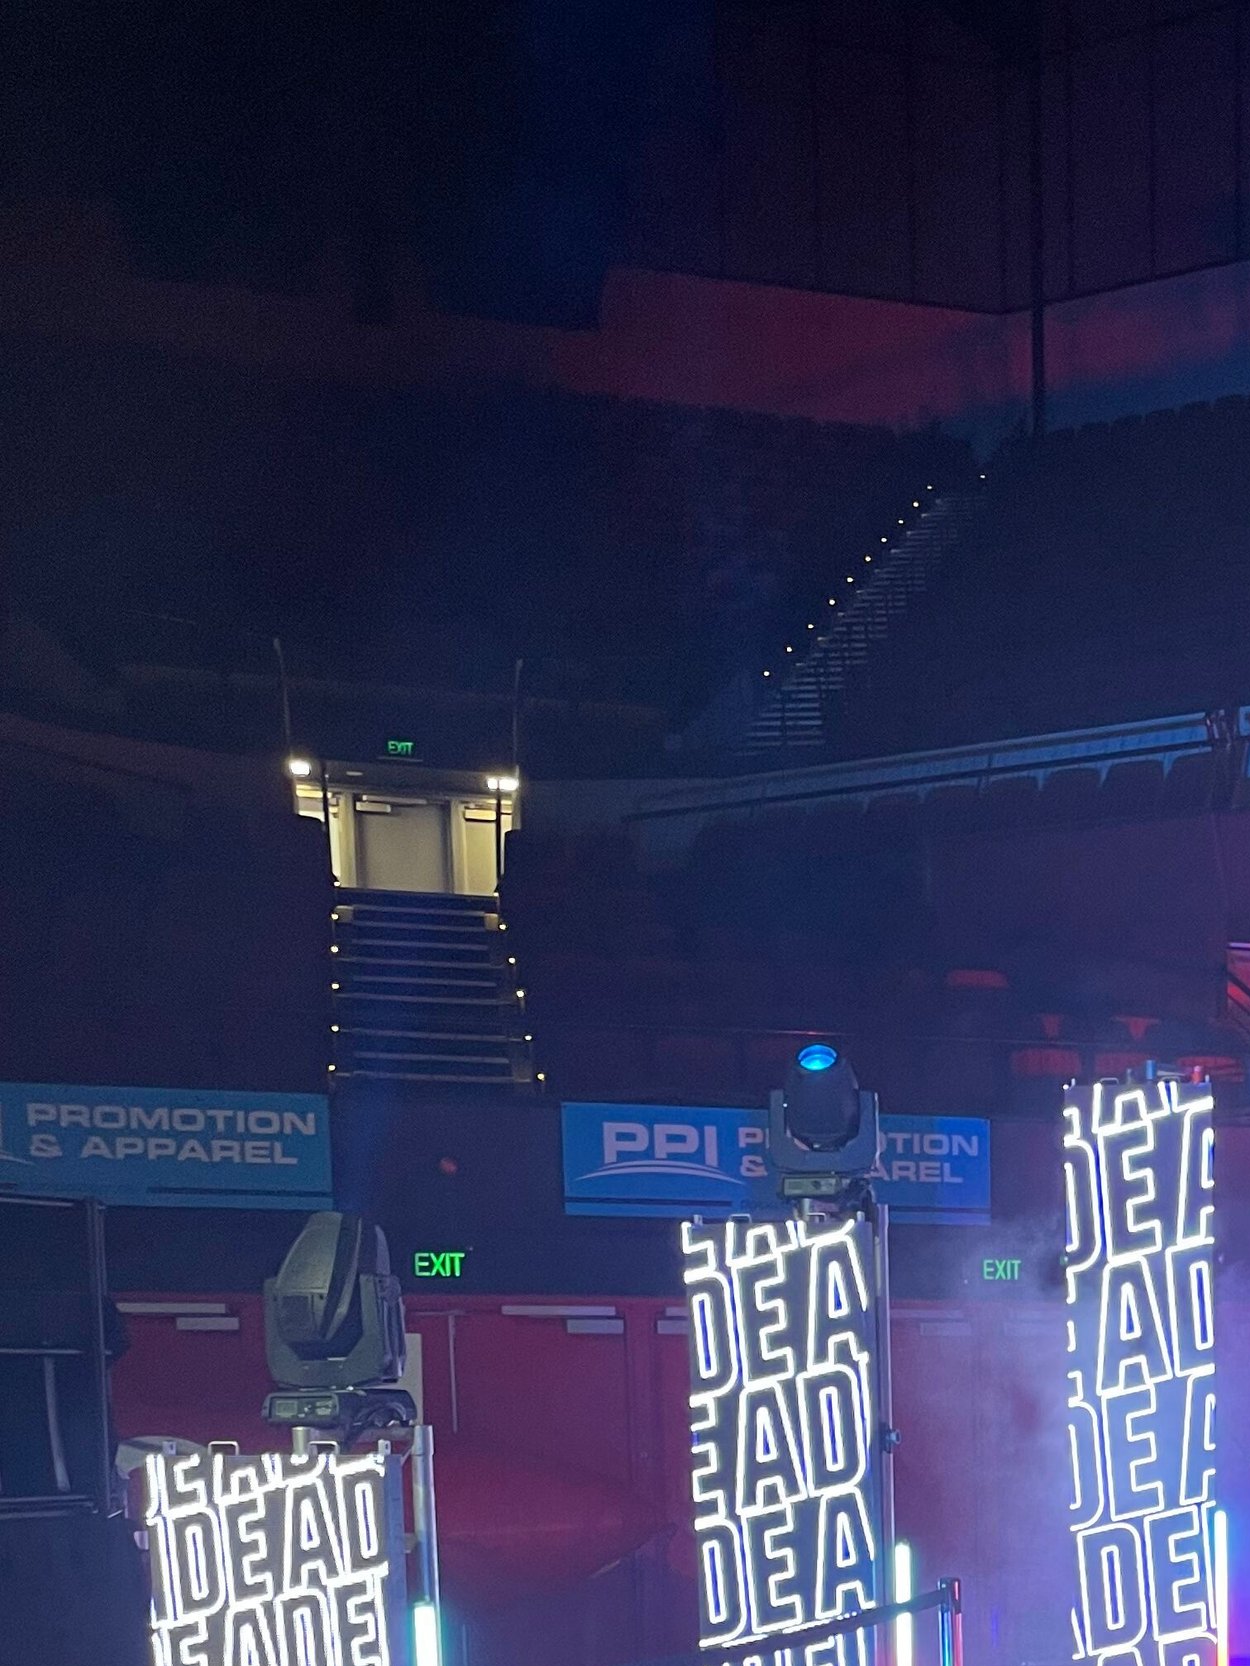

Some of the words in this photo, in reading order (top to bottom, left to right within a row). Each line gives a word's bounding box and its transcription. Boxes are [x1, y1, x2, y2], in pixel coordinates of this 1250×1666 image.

[387, 740, 414, 755] EXIT
[26, 1101, 316, 1136] PROMOTION
[29, 1134, 62, 1158] &
[80, 1136, 298, 1165] APPAREL
[601, 1120, 719, 1168] PPI
[738, 1126, 979, 1157] PTION
[739, 1155, 768, 1178] &
[414, 1251, 465, 1277] EXIT
[983, 1258, 1021, 1281] EXIT
